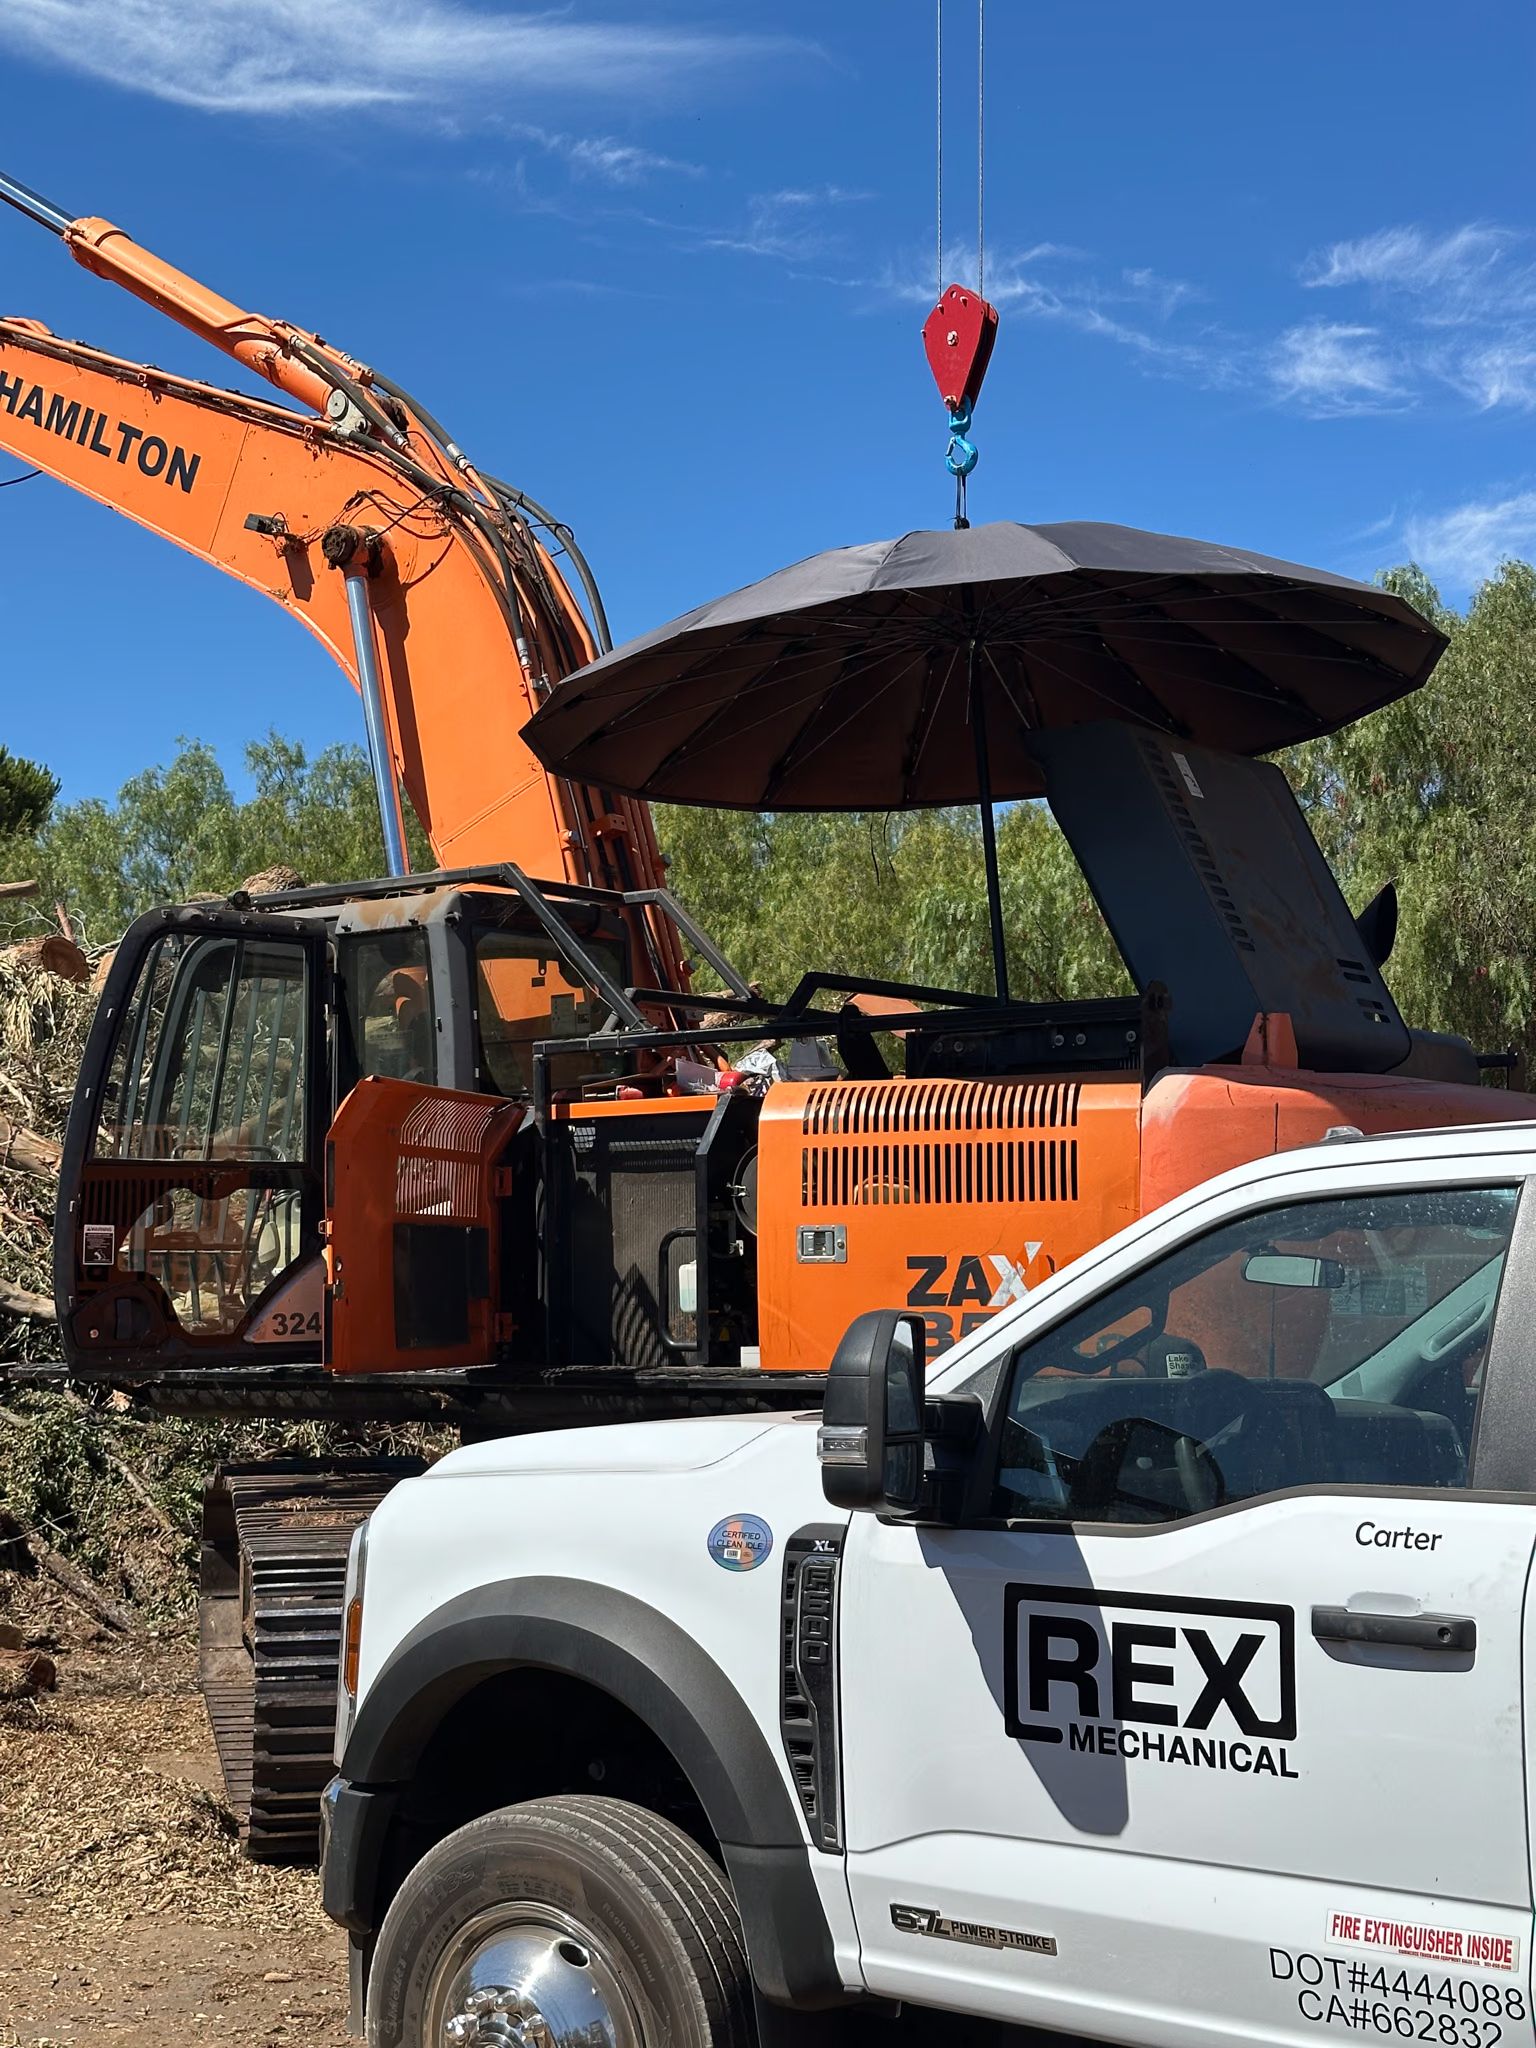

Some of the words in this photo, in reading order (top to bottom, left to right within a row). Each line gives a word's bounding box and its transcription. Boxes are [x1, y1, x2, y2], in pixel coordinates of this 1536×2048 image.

[0, 370, 200, 494] HAMILTON
[907, 1242, 1056, 1306] ZAX
[272, 1312, 322, 1336] 324
[717, 1539, 742, 1548] CLEAN
[745, 1541, 764, 1550] IDLE
[722, 1530, 761, 1540] CERTIFIED
[812, 1540, 835, 1551] XL
[1356, 1521, 1443, 1551] Carter
[1029, 1614, 1265, 1735] REX
[1069, 1723, 1299, 1779] MECHANICAL
[890, 1903, 950, 1935] 6.7L
[951, 1921, 996, 1940] POWER
[999, 1929, 1051, 1950] STROKE
[1332, 1914, 1361, 1940] FIRE
[1364, 1919, 1463, 1956] EXTINGUISHER
[1467, 1935, 1512, 1963] INSIDE
[1269, 1948, 1526, 2021] DOT#4444088
[1299, 1990, 1503, 2048] CA#662832
